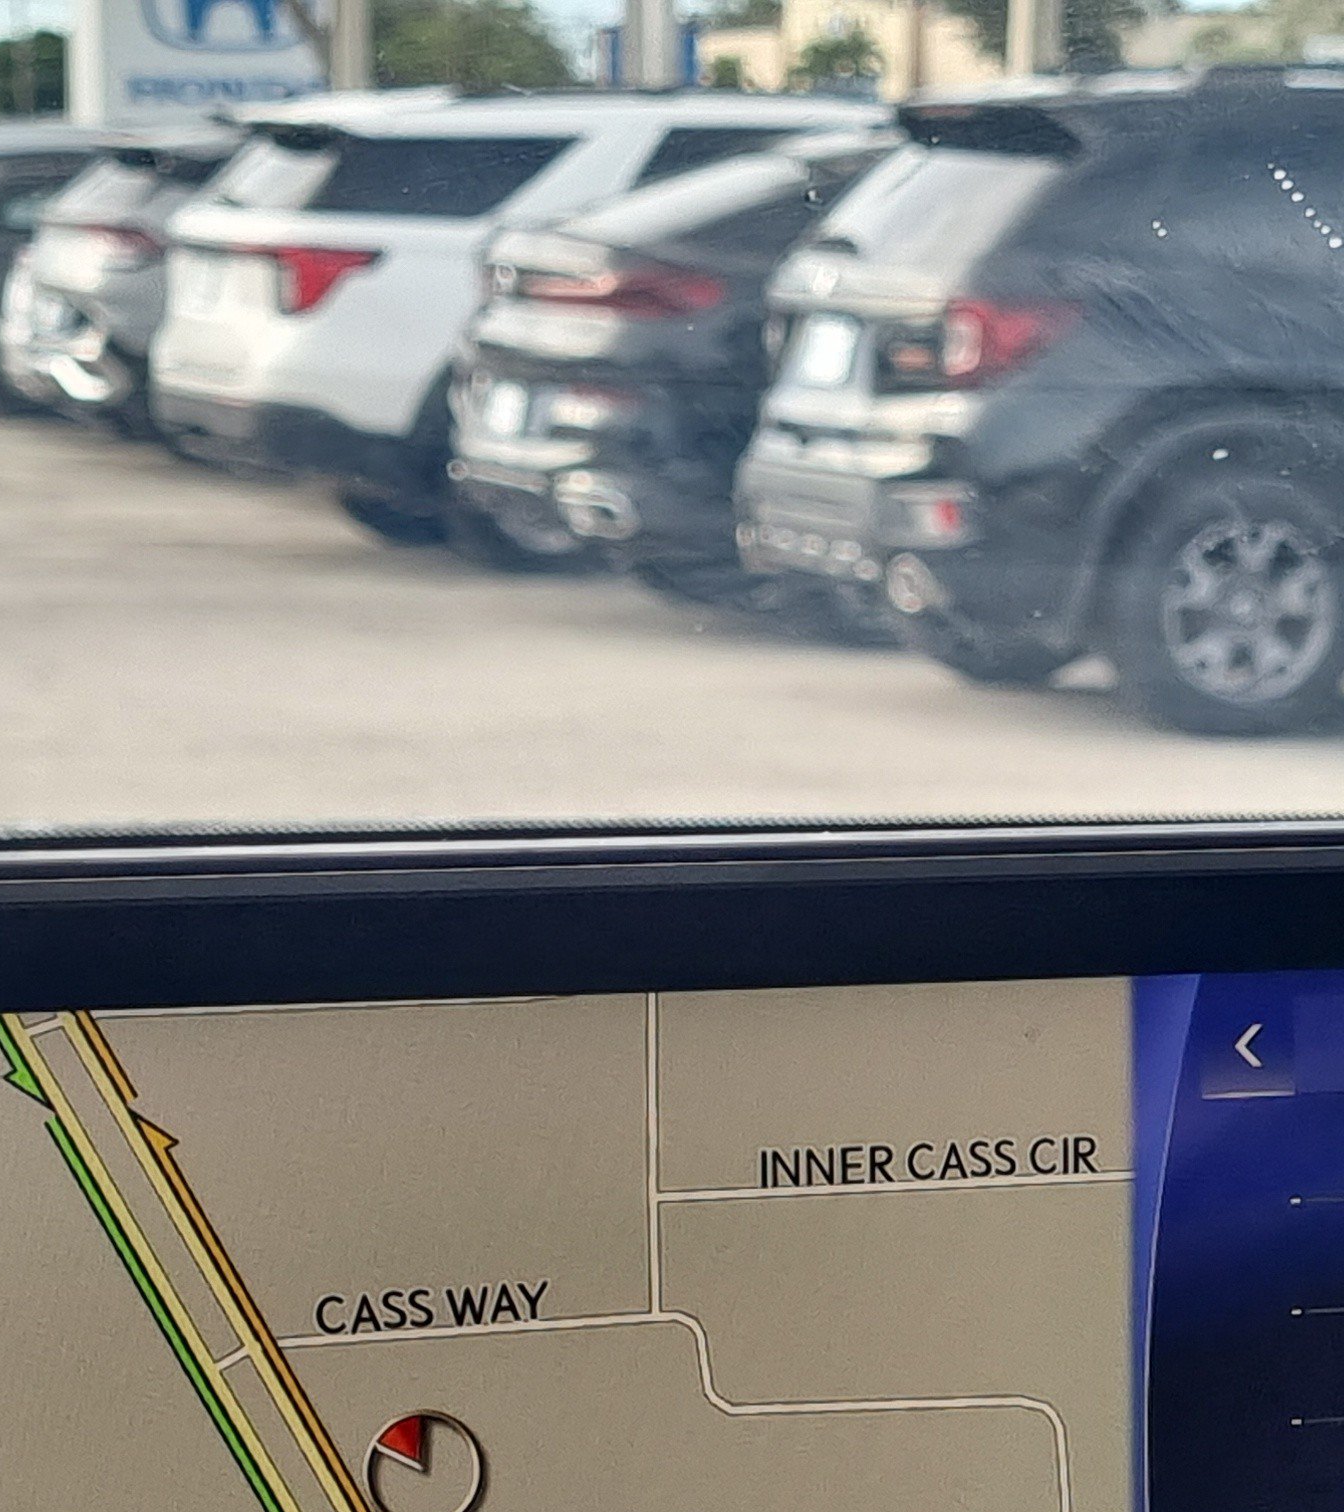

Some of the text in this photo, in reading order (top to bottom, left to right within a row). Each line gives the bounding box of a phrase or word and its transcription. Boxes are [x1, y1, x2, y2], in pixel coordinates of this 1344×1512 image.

[759, 1136, 1099, 1189] INNER CASS CIR
[315, 1279, 549, 1335] CASS WAY
